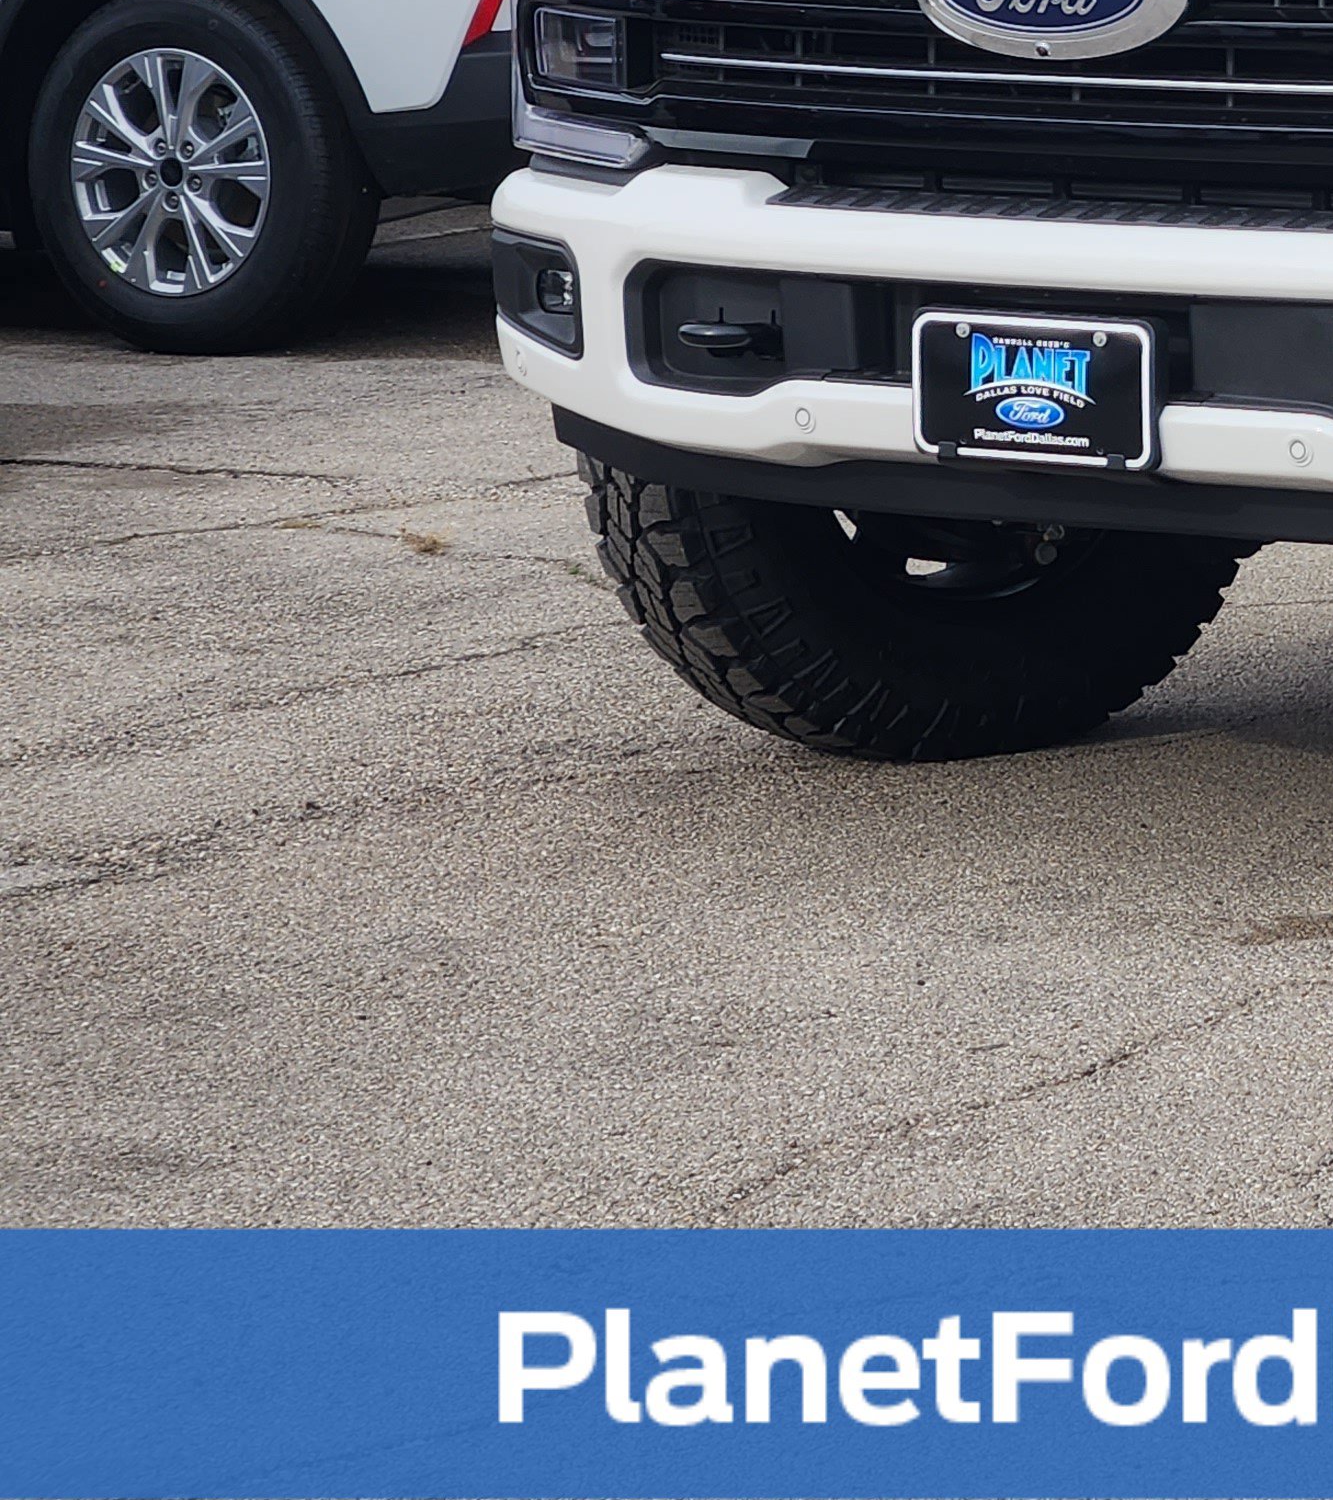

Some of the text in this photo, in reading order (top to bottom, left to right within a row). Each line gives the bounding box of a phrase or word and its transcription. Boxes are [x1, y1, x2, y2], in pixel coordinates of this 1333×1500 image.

[971, 333, 1091, 396] PLANET
[976, 386, 1086, 409] DALLAS LOVE FIELD
[1008, 401, 1051, 424] Ford
[973, 428, 1090, 448] PlanetFordDallas.com
